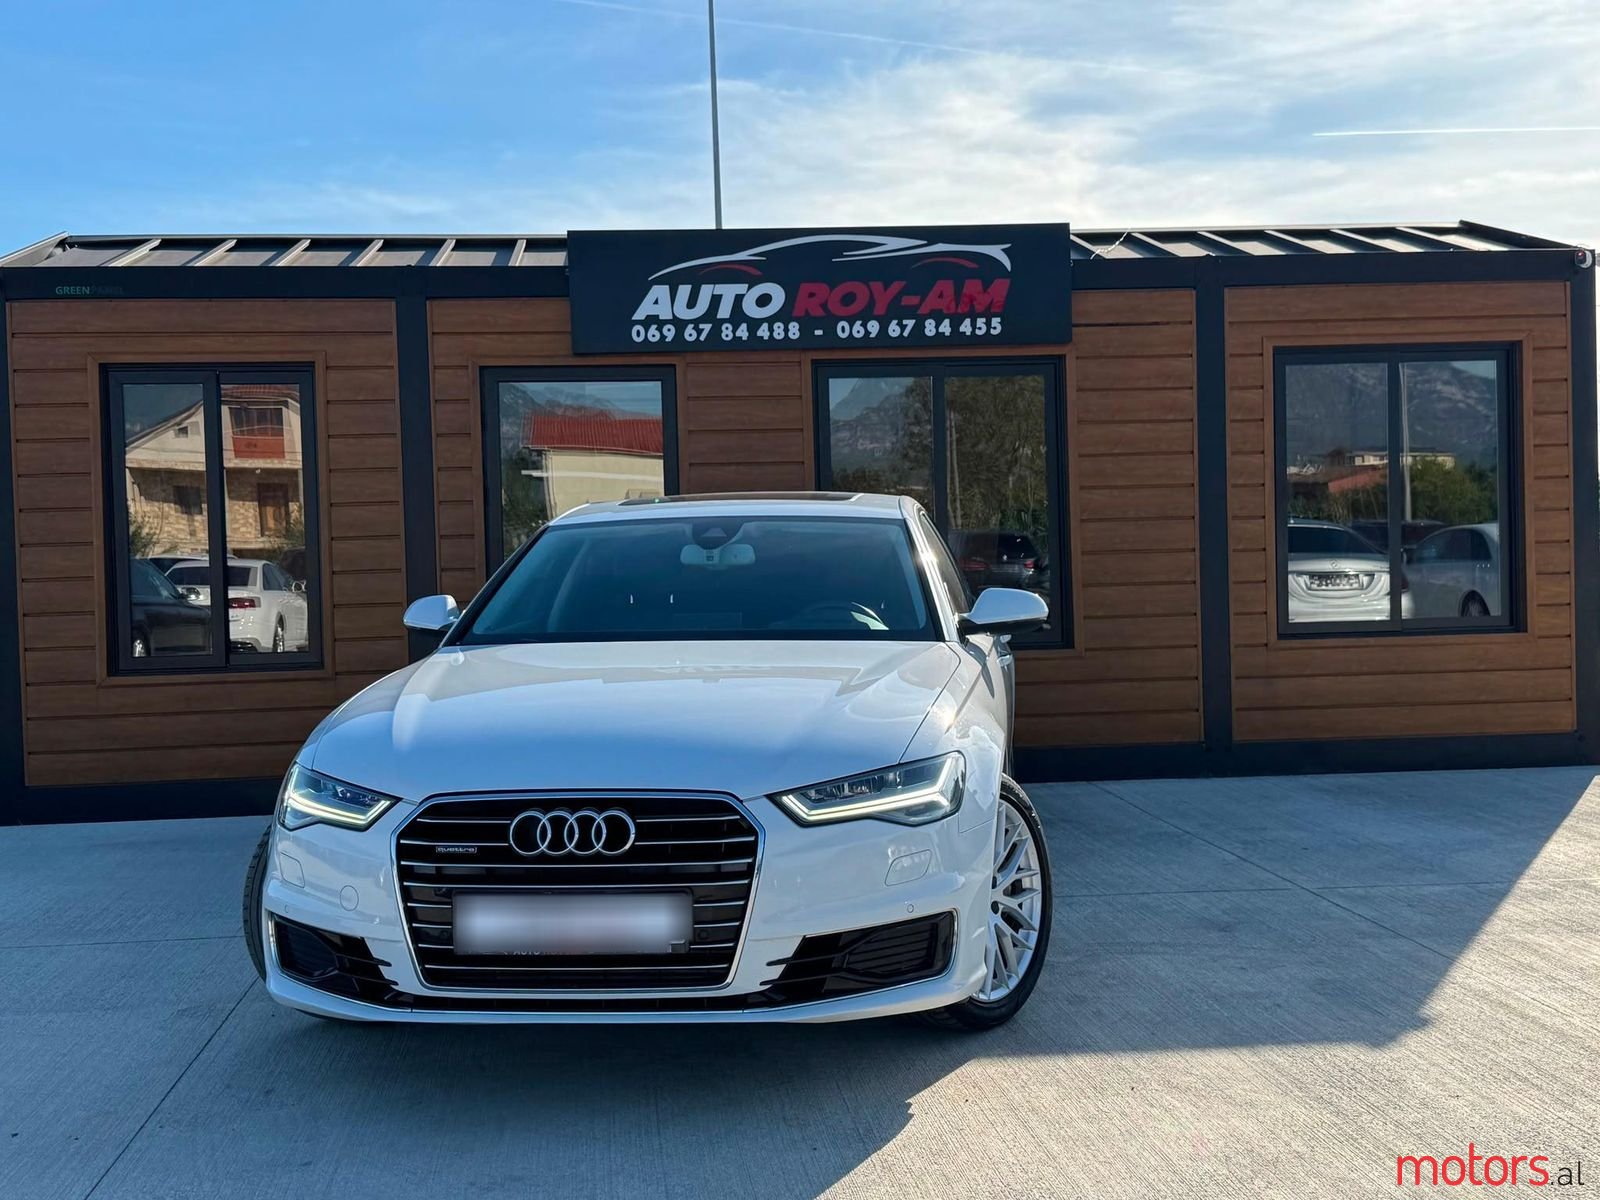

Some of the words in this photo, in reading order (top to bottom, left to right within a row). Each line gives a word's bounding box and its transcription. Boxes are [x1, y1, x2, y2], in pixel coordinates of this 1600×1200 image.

[631, 282, 786, 321] AUTO
[792, 278, 1011, 317] ROY-AM
[631, 324, 676, 343] 069
[683, 323, 712, 342] 67
[721, 322, 749, 341] 84
[756, 321, 800, 340] 488
[836, 320, 880, 339] 069
[887, 319, 916, 338] 67
[924, 318, 952, 336] 84
[959, 317, 1002, 336] 455
